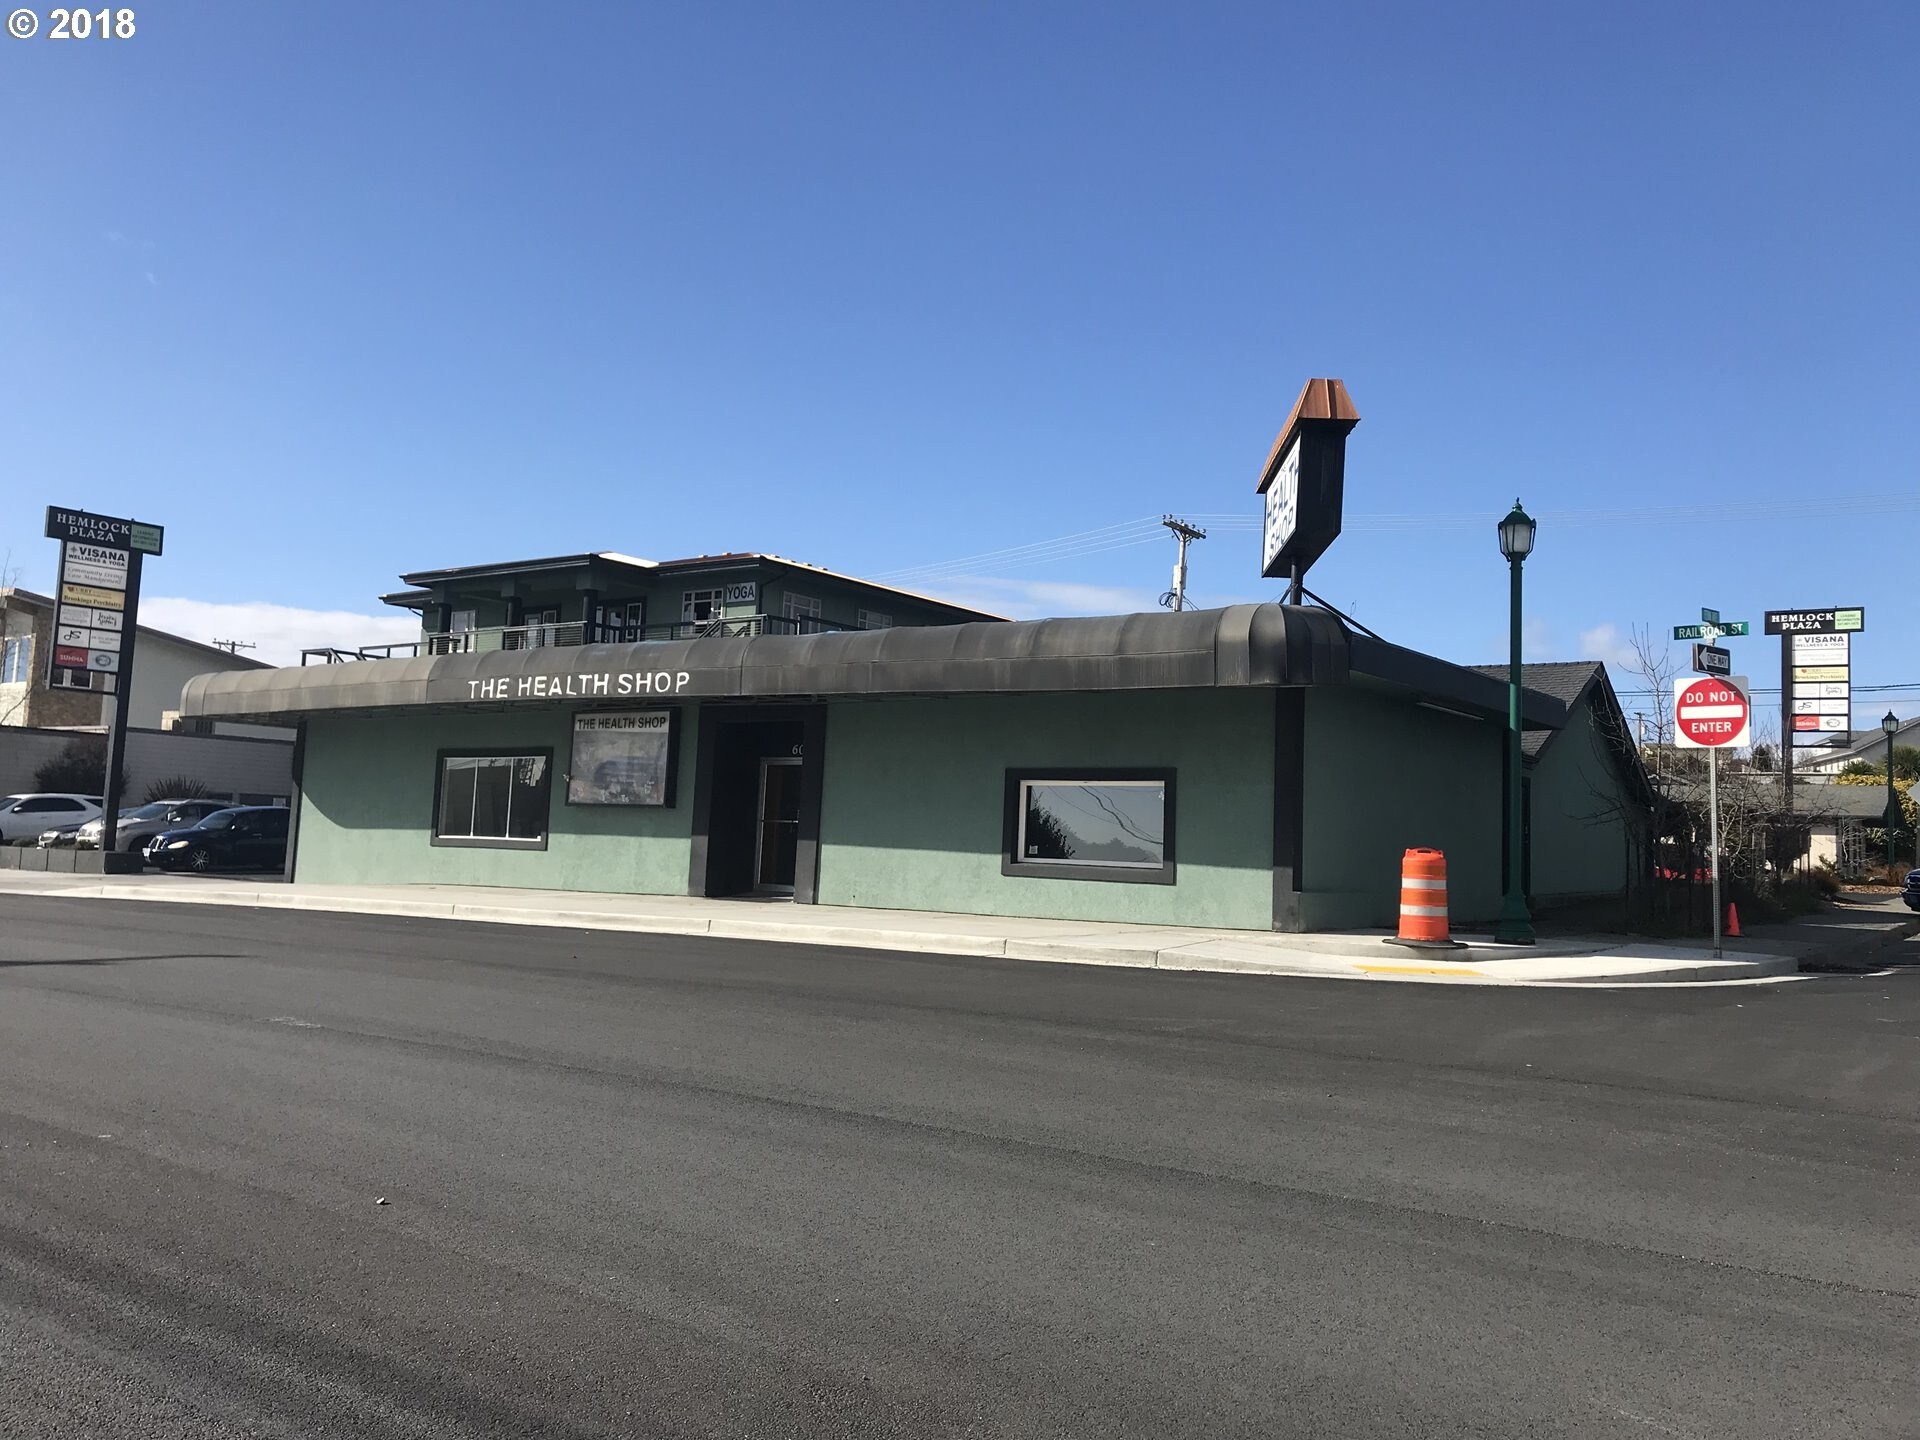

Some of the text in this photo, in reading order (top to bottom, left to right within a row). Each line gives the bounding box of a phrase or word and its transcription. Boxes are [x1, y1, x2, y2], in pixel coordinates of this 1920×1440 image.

[1266, 456, 1299, 534] HEALTH
[57, 513, 130, 535] HEMLOCK
[69, 525, 115, 543] PLAZA
[1269, 507, 1294, 560] SHOP
[68, 554, 101, 563] WELLNESS
[79, 547, 125, 562] VISANA
[728, 585, 754, 599] YOGA
[1771, 612, 1834, 623] HEMLOCK
[1679, 623, 1743, 638] RAILROAD ST
[1782, 621, 1822, 630] PLAZA
[1707, 653, 1728, 668] ONE WAY
[468, 672, 690, 699] THE HEALTH SHOP
[1686, 691, 1736, 703] DO NOT
[577, 716, 667, 730] THE HEALTH SHOP
[1691, 722, 1732, 734] ENTER
